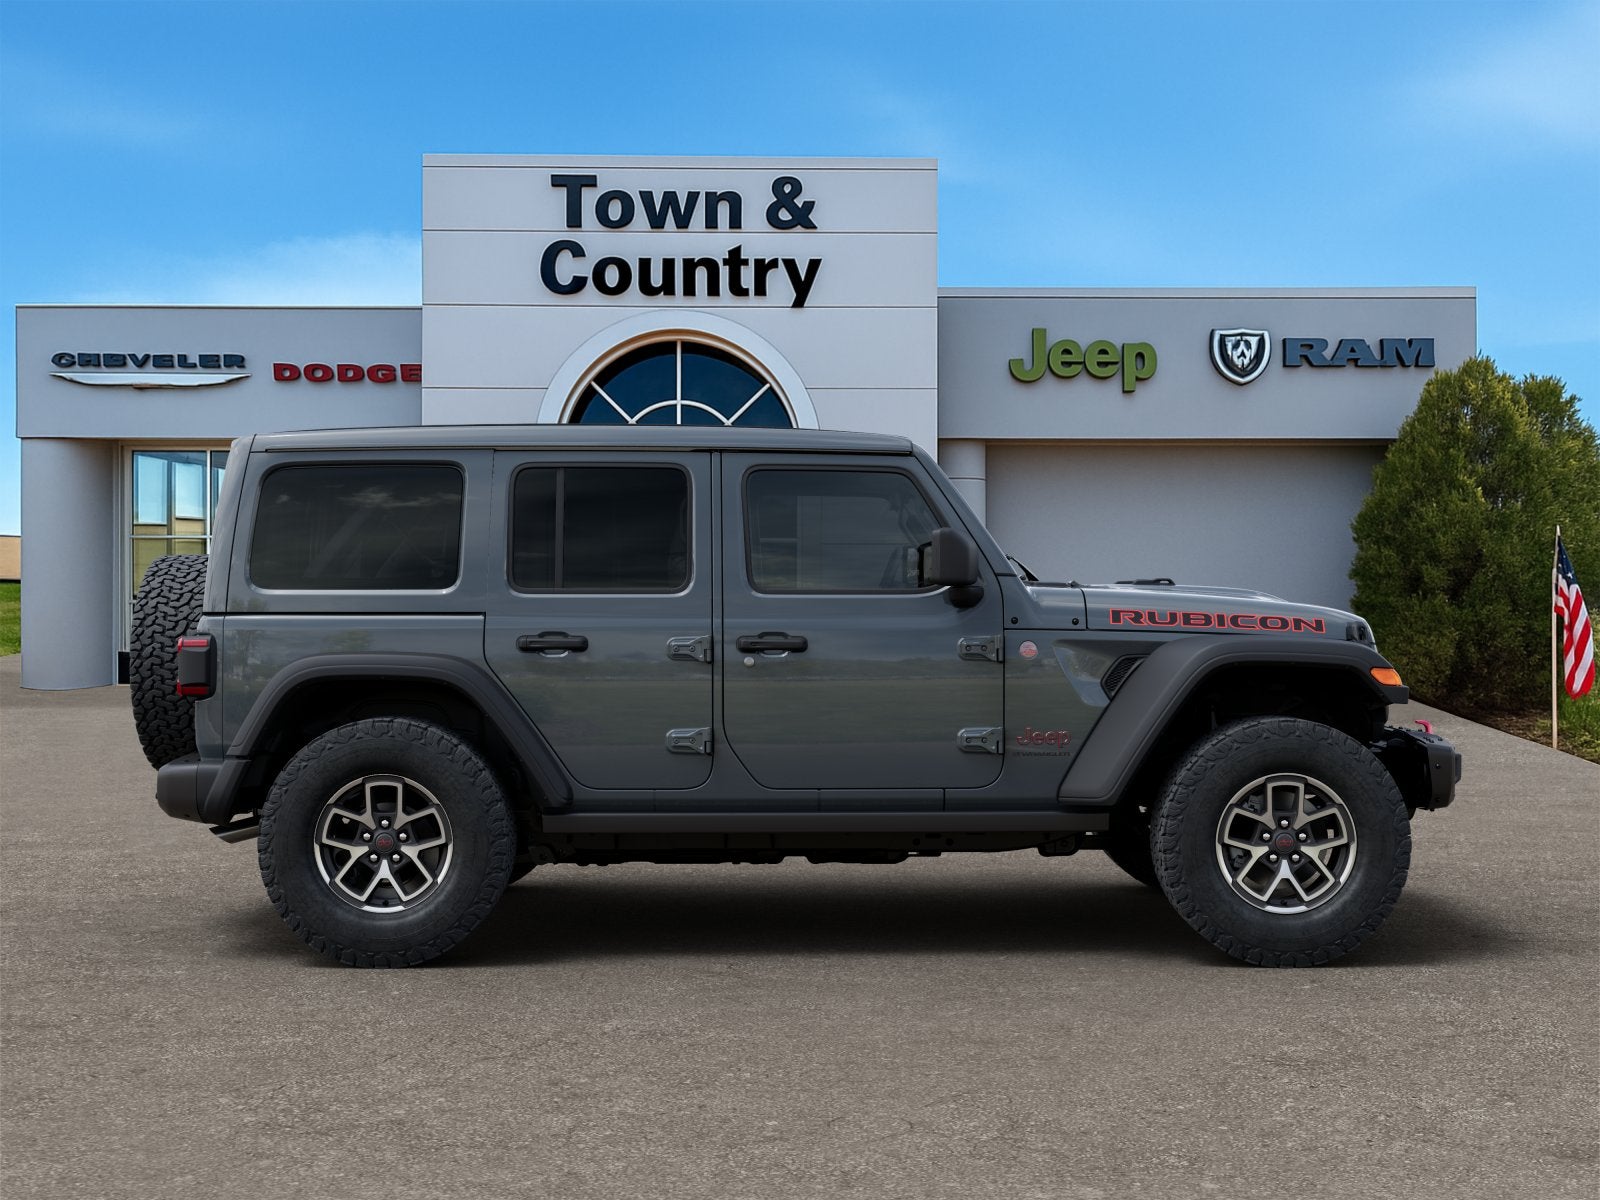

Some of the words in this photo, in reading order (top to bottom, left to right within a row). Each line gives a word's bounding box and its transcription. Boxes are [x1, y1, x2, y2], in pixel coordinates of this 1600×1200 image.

[550, 174, 743, 230] Town
[765, 175, 818, 230] &
[540, 239, 823, 308] Country
[1008, 327, 1158, 393] Jeep
[1282, 337, 1436, 368] RAM
[273, 362, 422, 384] DODGE
[1109, 608, 1326, 634] RUBICON
[1016, 727, 1071, 749] Jeep
